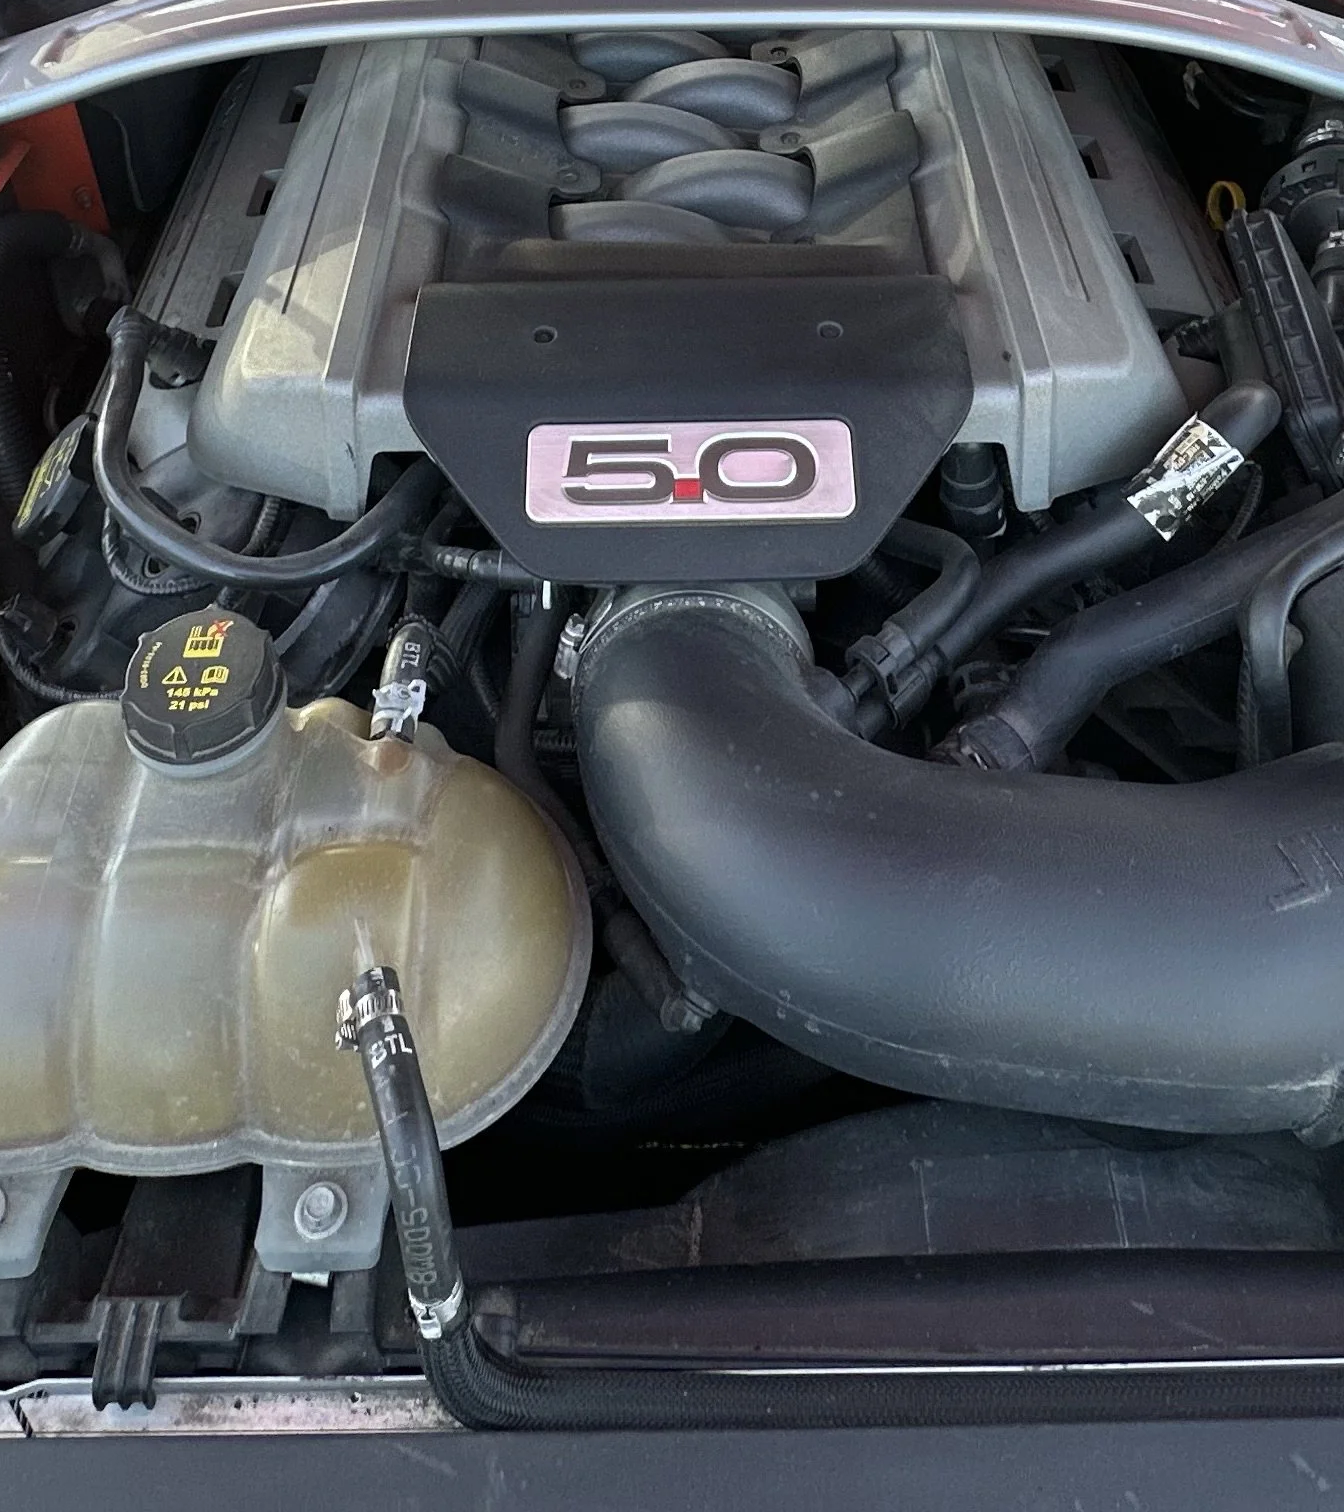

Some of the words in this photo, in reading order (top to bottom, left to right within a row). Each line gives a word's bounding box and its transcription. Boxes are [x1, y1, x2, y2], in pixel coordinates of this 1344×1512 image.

[560, 431, 820, 506] 5.0
[193, 687, 219, 697] kPa
[168, 700, 186, 710] 21
[188, 699, 210, 712] psi
